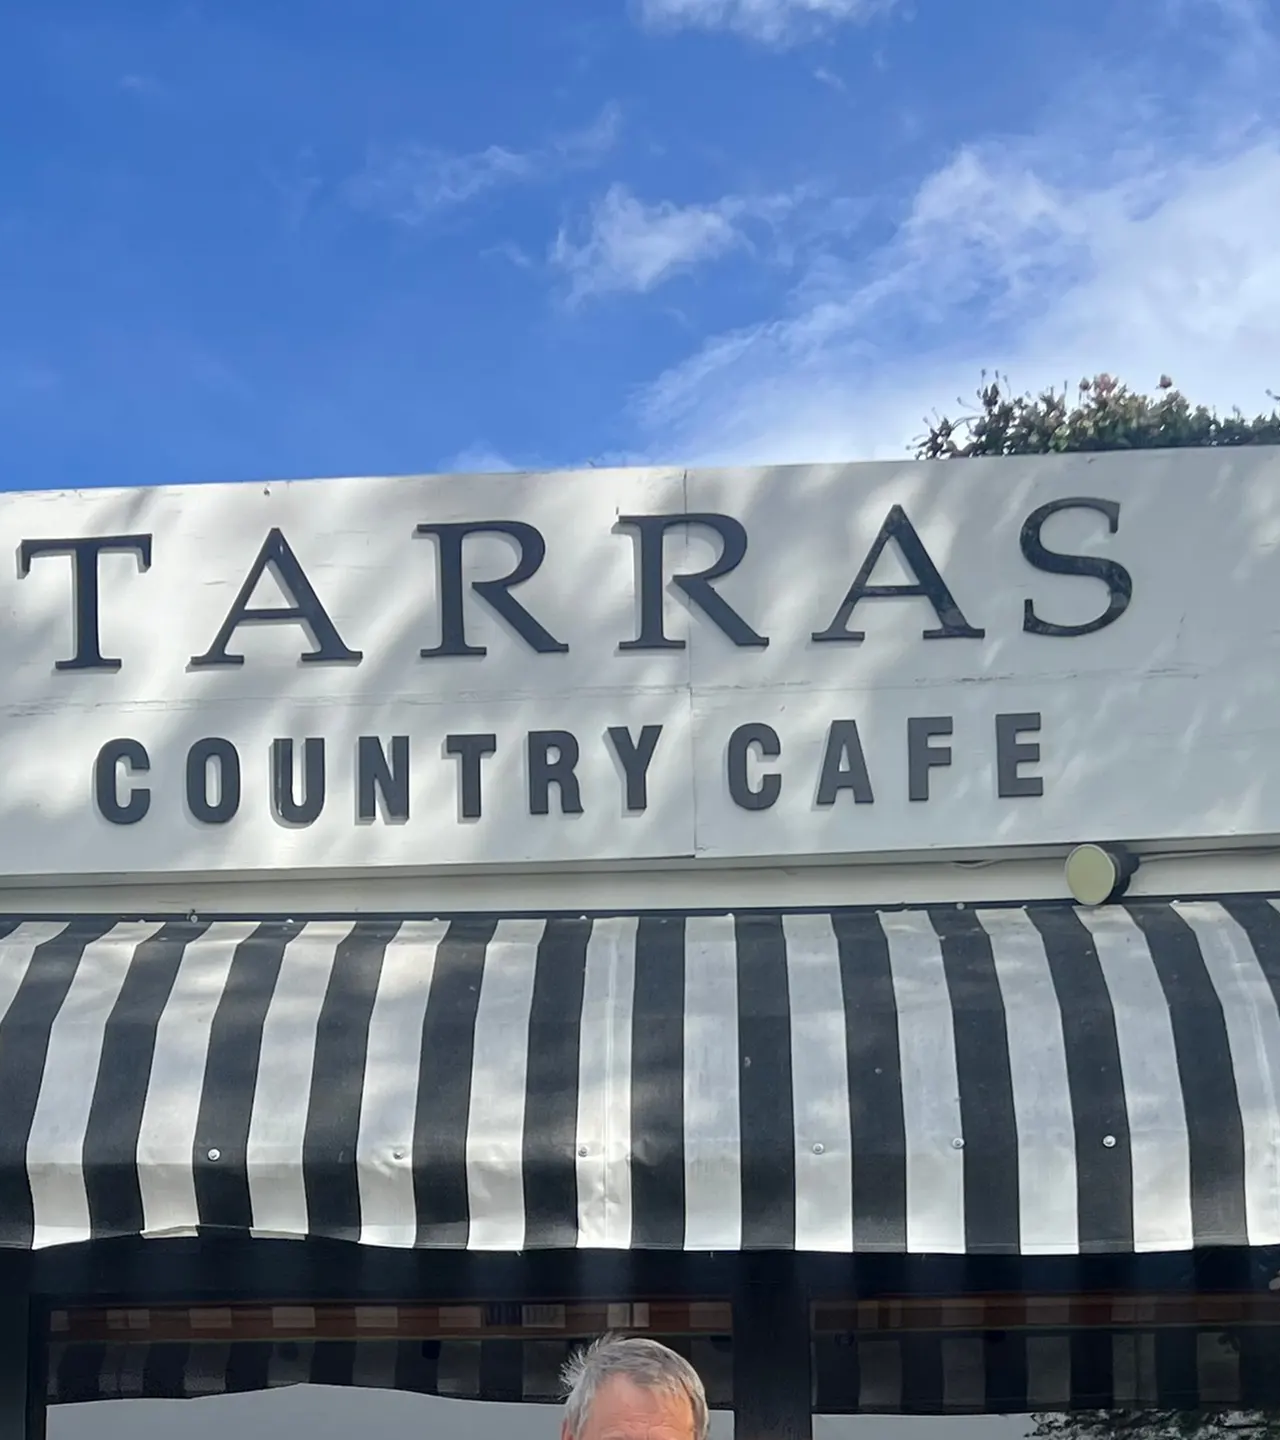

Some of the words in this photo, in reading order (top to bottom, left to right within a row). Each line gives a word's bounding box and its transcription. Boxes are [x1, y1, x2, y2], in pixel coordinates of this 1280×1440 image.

[17, 497, 1136, 672] TARRAS
[93, 722, 664, 827] COUNTRY
[725, 711, 1046, 812] CAFE
